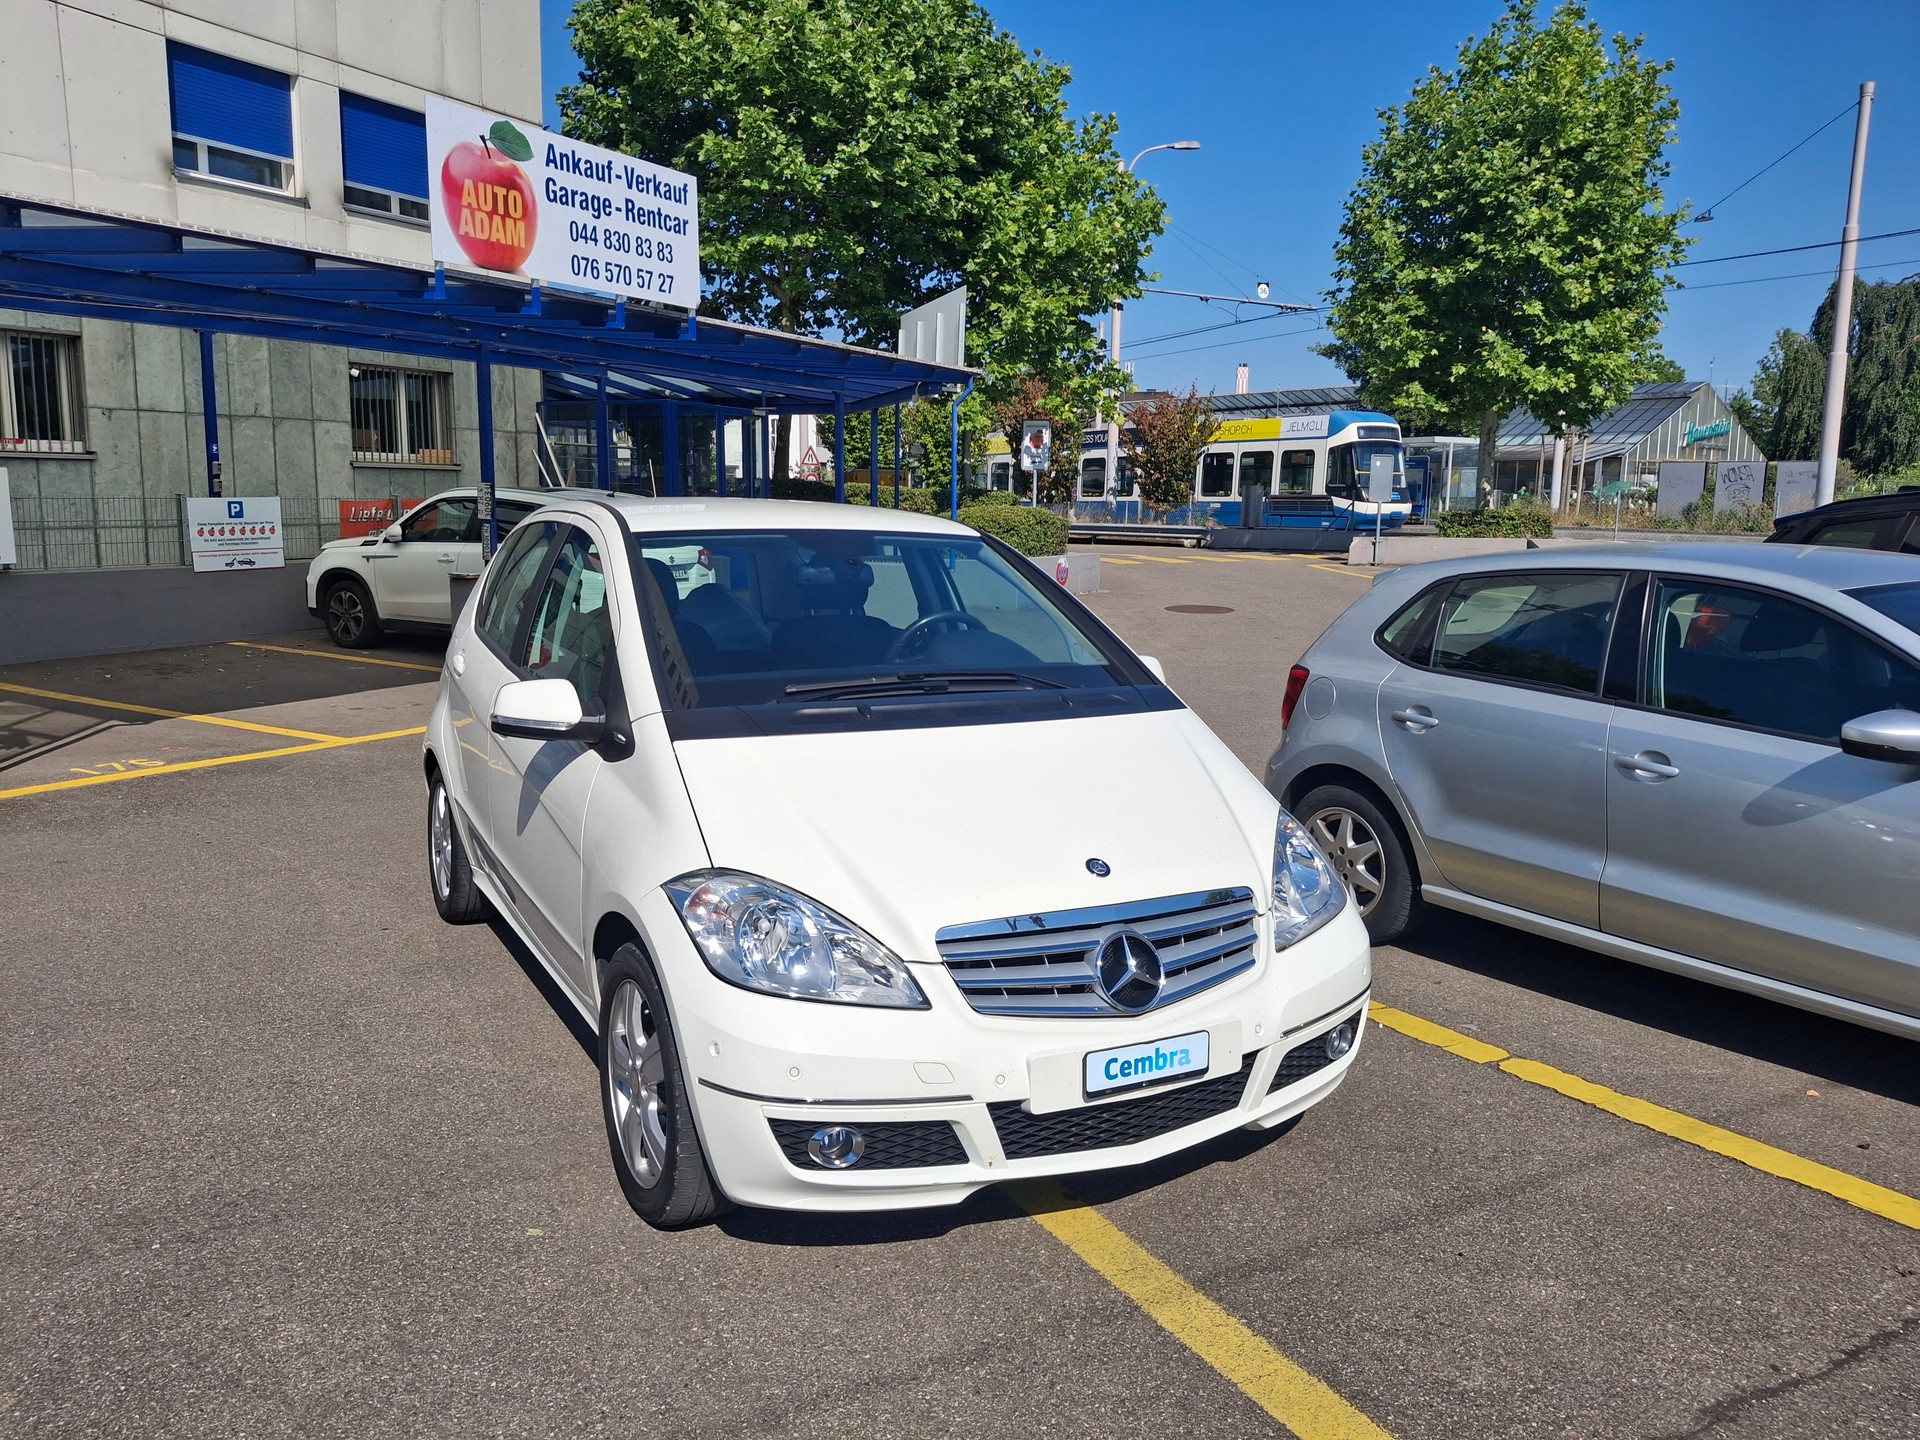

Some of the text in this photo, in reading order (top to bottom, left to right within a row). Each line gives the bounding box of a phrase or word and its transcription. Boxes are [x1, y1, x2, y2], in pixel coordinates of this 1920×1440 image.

[461, 178, 523, 219] AUTO
[458, 208, 526, 248] ADAM
[569, 220, 673, 263] 044 830 83 83
[571, 254, 674, 294] 076 570 57 27
[1219, 424, 1253, 436] SHOP.CH
[1286, 420, 1323, 432] JELMOLI
[230, 503, 240, 516] P
[1104, 1047, 1191, 1081] Cembra
